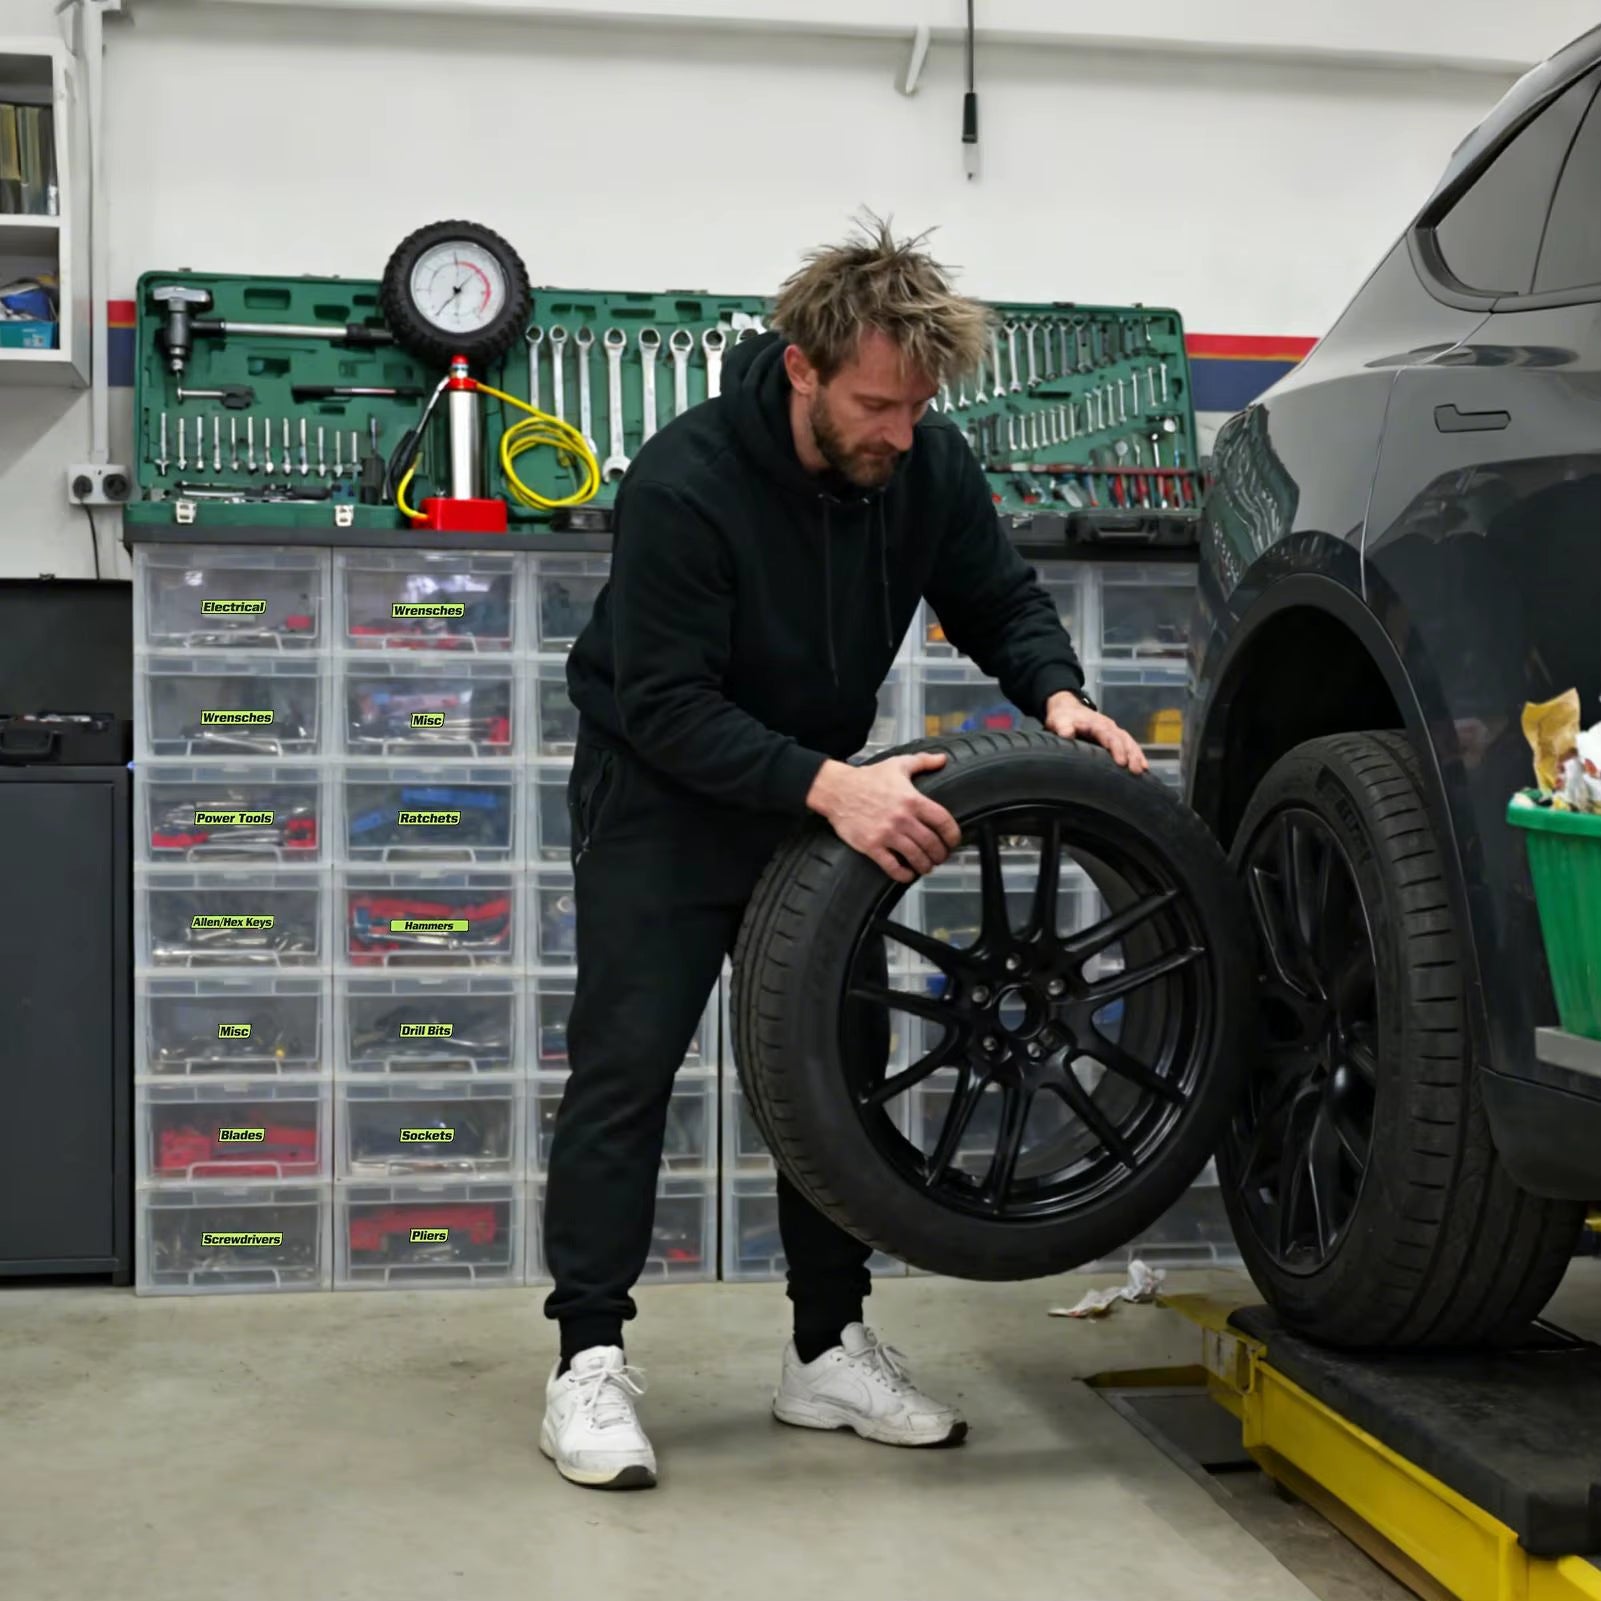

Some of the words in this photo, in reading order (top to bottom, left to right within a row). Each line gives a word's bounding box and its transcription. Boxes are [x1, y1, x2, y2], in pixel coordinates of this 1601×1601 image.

[203, 602, 264, 612] Electrical
[395, 606, 463, 616] Wrensches
[203, 713, 271, 723] Wrensches
[413, 715, 442, 726] Misc
[196, 813, 236, 823] Power
[239, 813, 272, 823] Tools
[400, 813, 459, 823] Ratchets
[193, 917, 244, 928] Allen/Hex
[245, 917, 272, 929] Keys
[404, 921, 454, 930] Hammers
[220, 1026, 249, 1037] Misc
[401, 1026, 426, 1036] Drill
[427, 1026, 451, 1036] Bits
[220, 1130, 263, 1141] Blades
[402, 1131, 453, 1141] Sockets
[202, 1234, 281, 1245] Screwdrivers
[411, 1230, 446, 1241] Pliers
